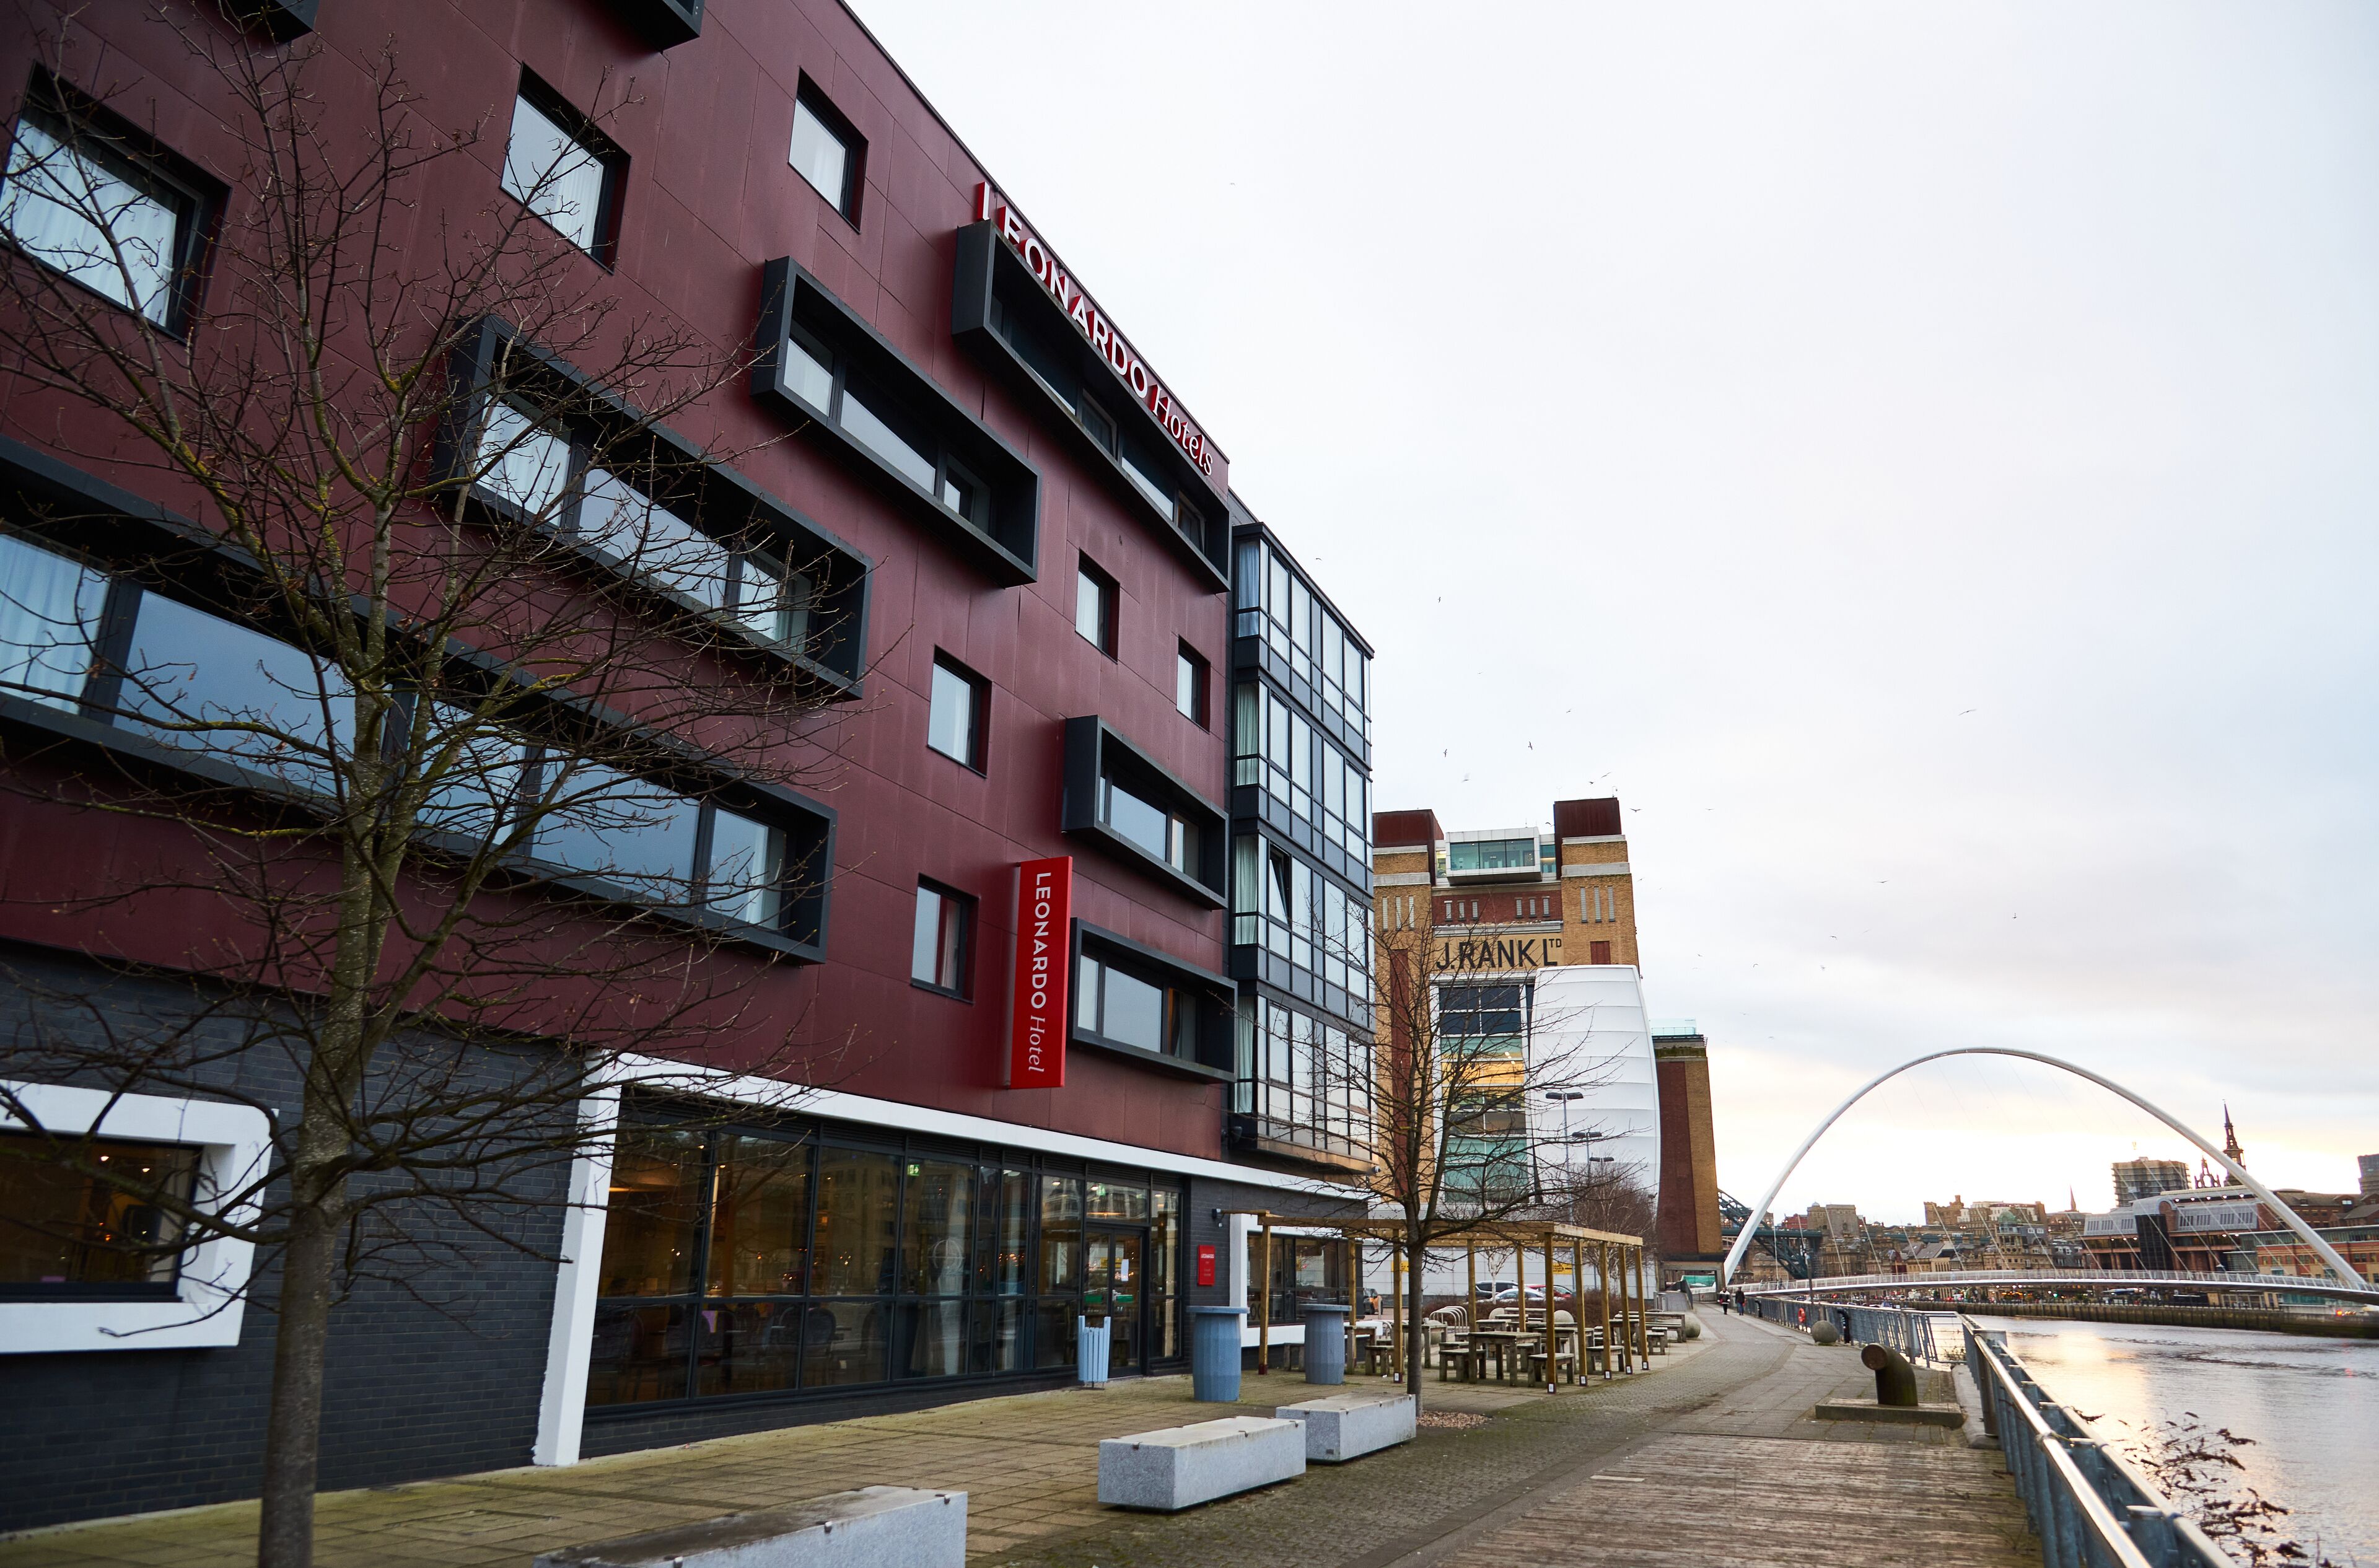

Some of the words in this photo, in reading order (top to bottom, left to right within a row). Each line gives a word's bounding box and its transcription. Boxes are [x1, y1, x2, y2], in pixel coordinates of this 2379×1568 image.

[978, 182, 1148, 398] LEONARDO
[1150, 384, 1212, 476] Hotels
[1031, 872, 1051, 1009] LEONARDO
[1028, 1015, 1046, 1072] Hotel
